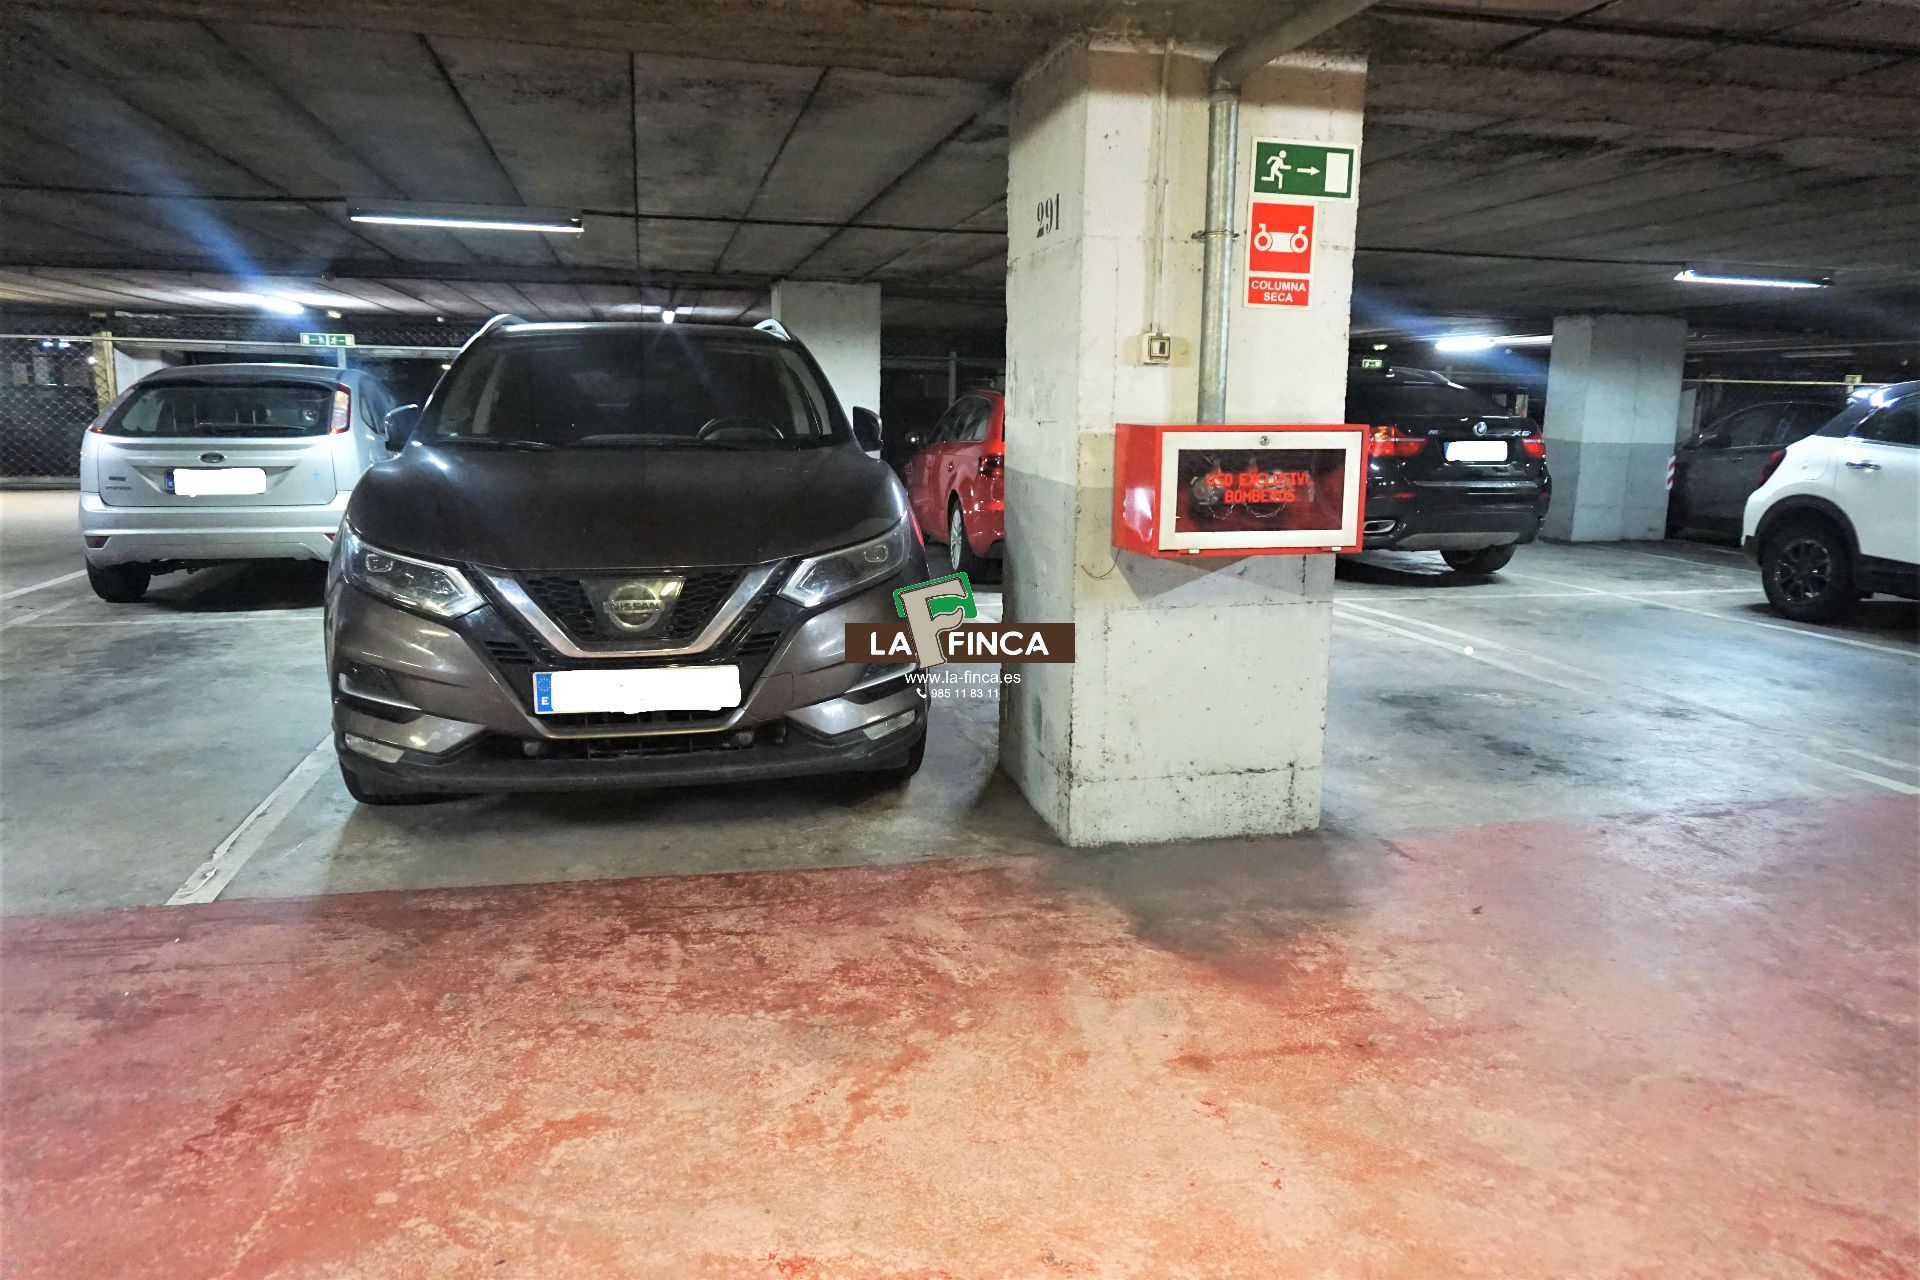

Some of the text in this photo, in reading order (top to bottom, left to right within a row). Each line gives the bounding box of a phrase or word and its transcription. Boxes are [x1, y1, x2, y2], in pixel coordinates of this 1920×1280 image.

[1036, 193, 1060, 238] 291
[1251, 280, 1307, 292] COLUMNA
[1263, 292, 1293, 302] SECA
[610, 602, 660, 611] NISSAN
[541, 697, 549, 705] E
